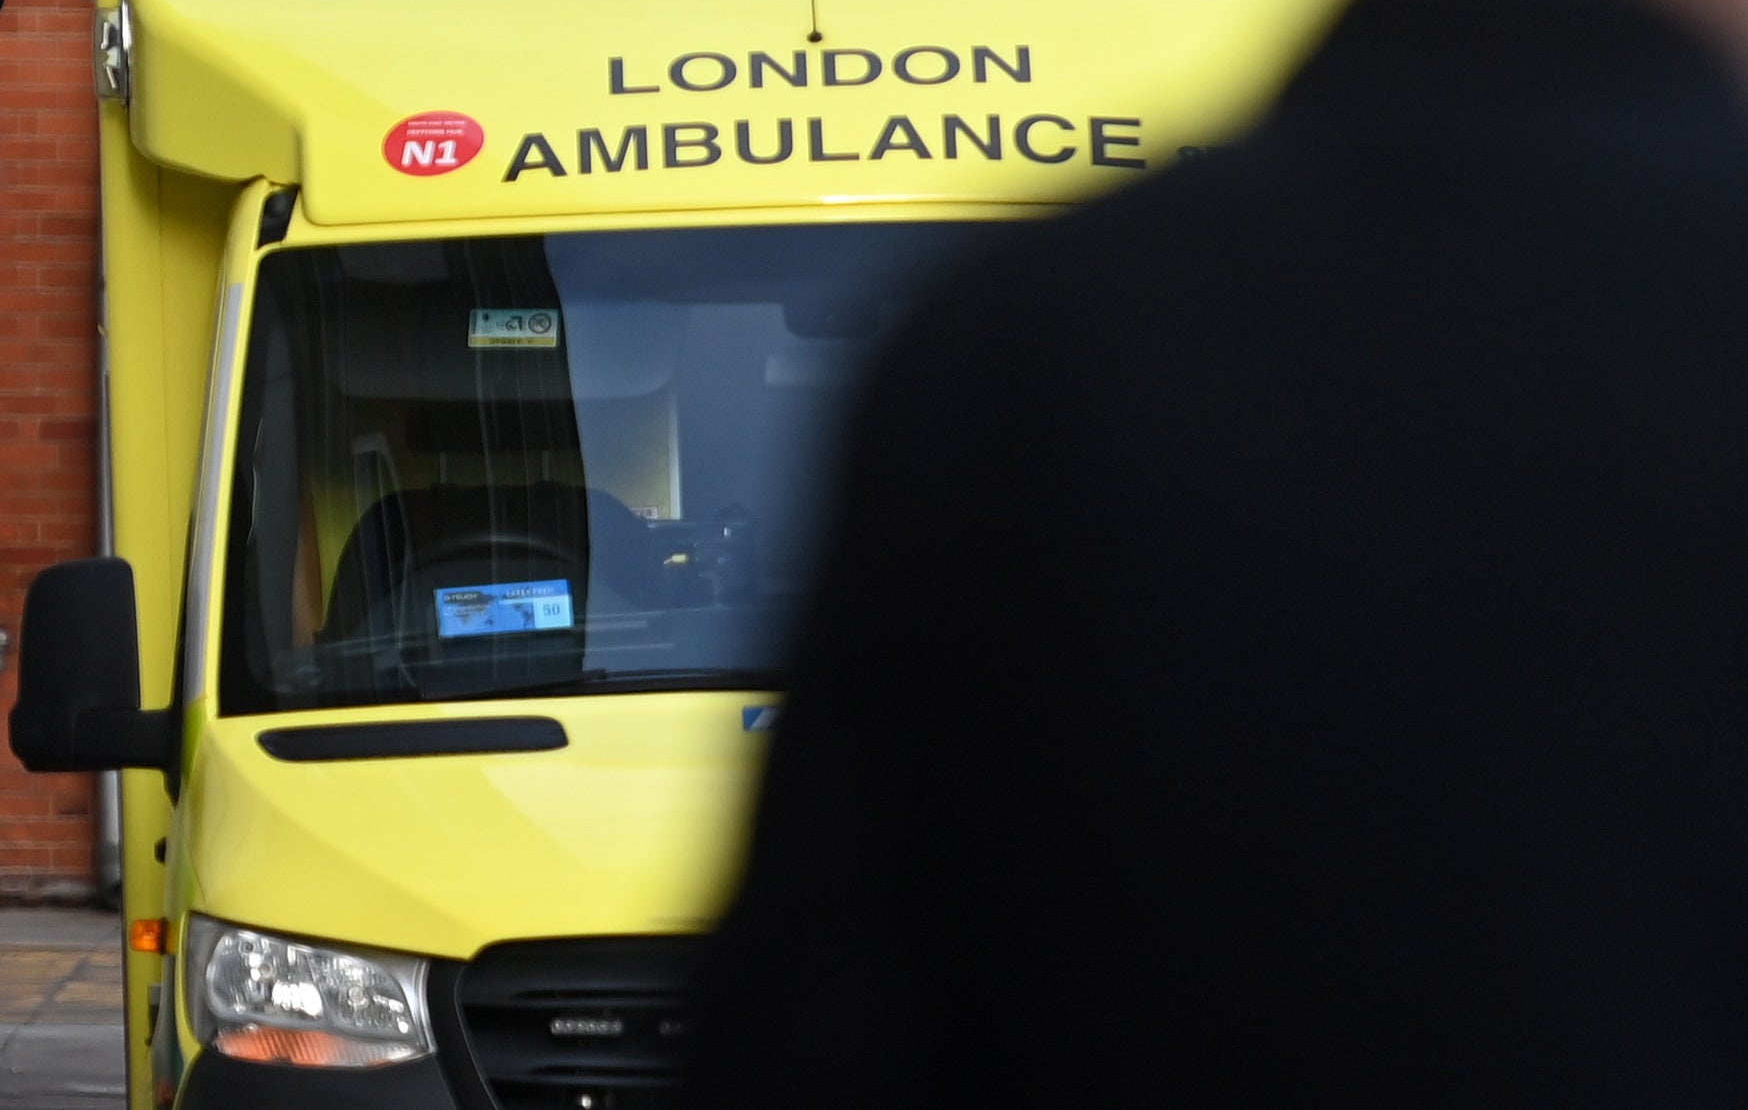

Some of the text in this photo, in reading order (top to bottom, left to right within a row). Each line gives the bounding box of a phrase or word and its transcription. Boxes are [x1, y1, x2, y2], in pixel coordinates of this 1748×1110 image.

[607, 44, 1033, 95] LONDON
[400, 139, 459, 168] N1
[501, 113, 1148, 183] AMBULANCE
[542, 603, 561, 617] 50
